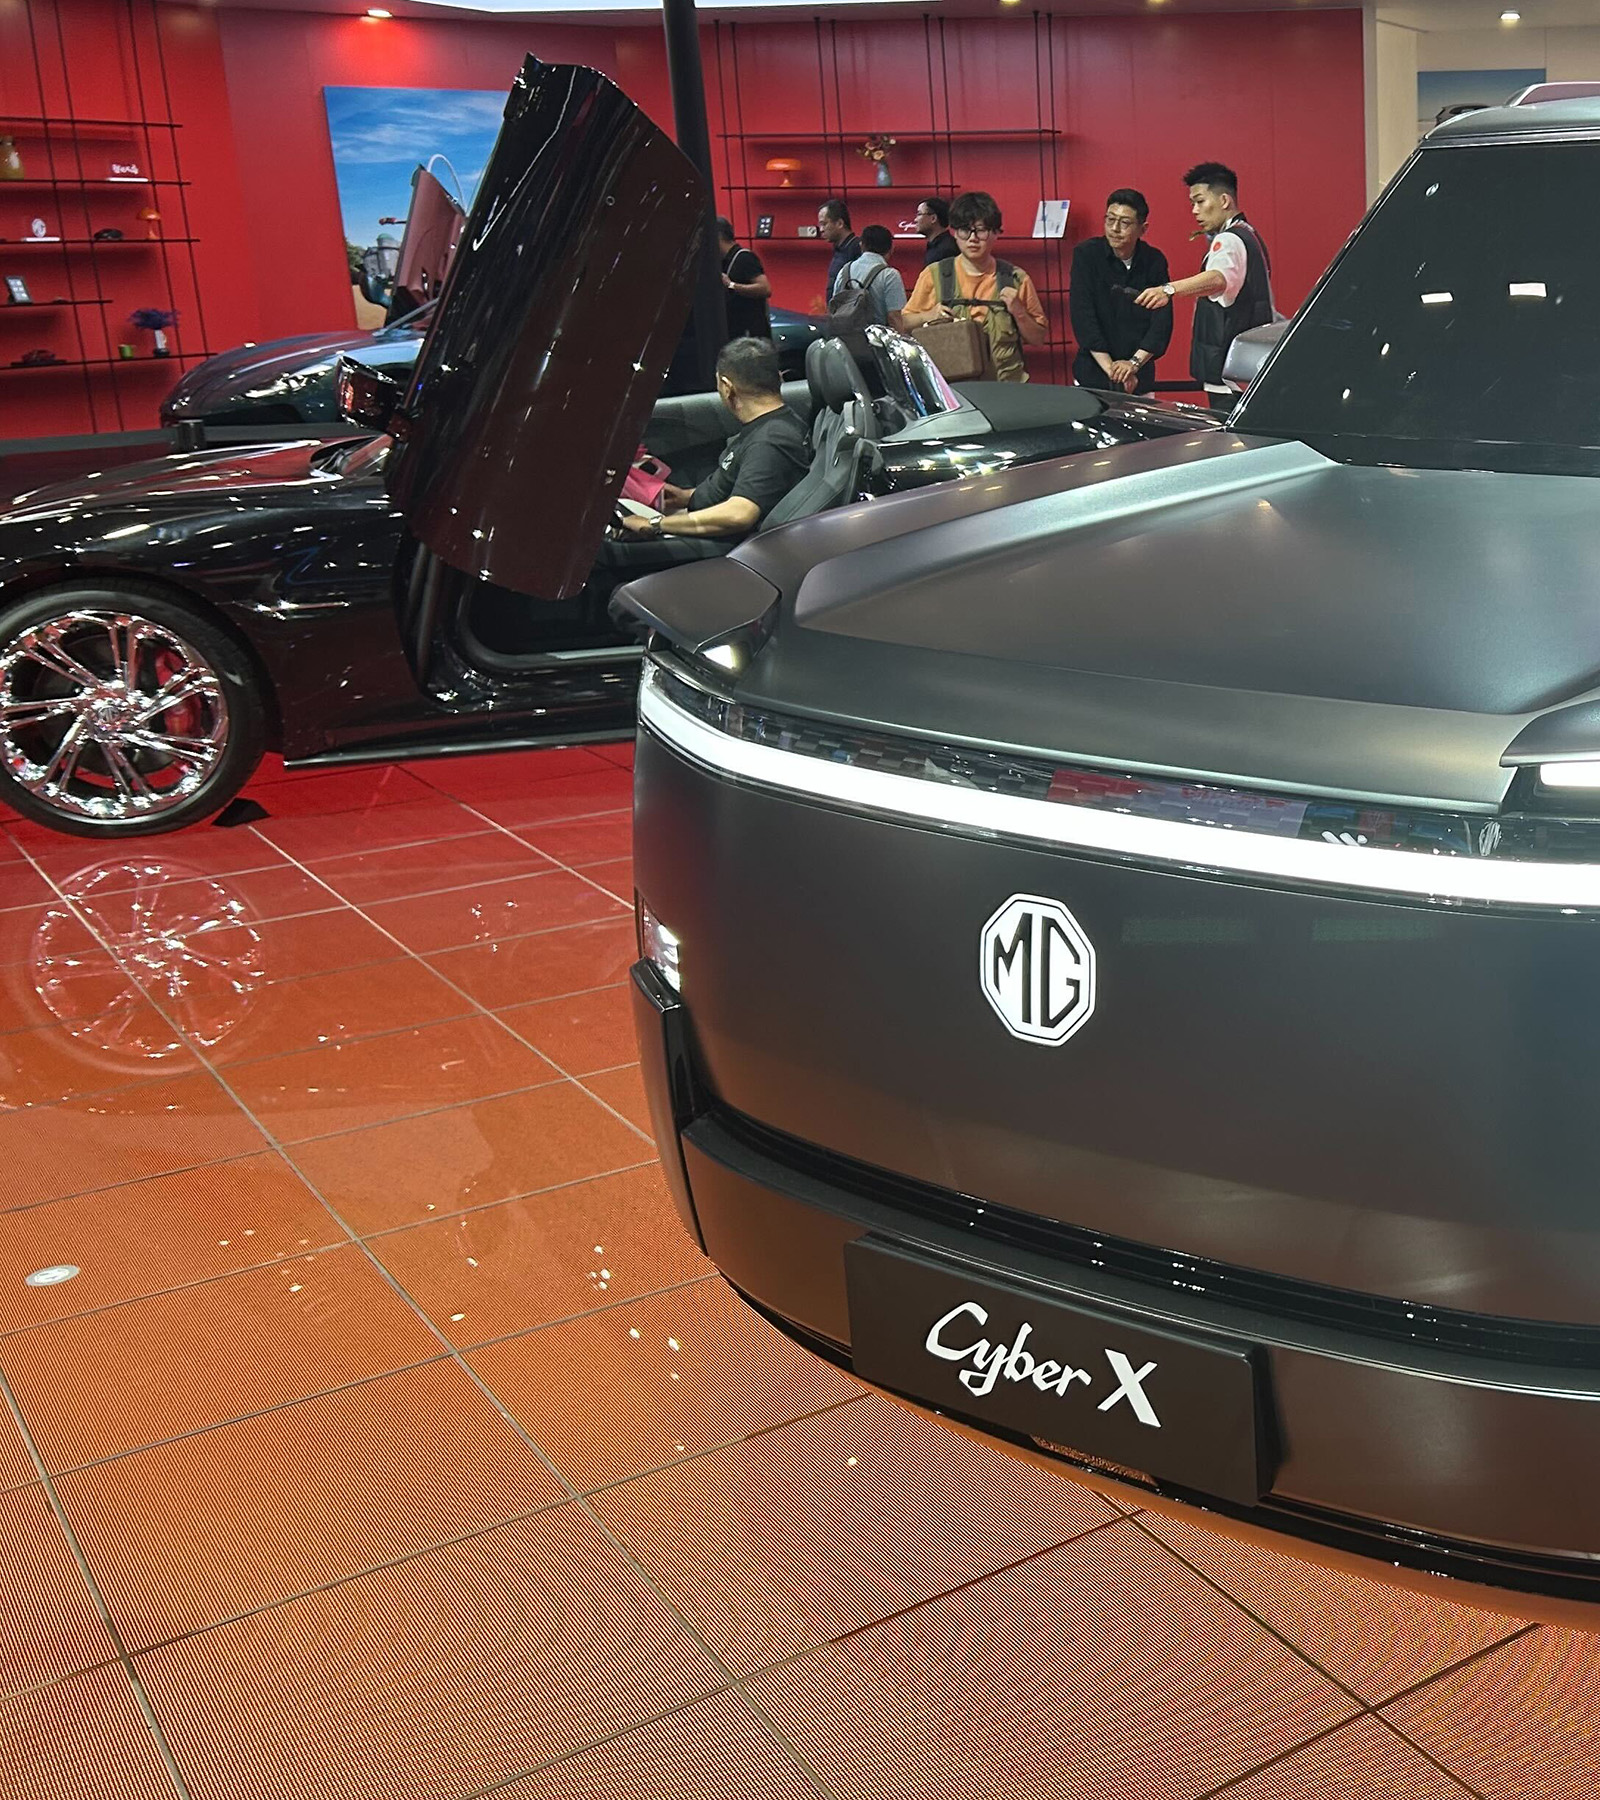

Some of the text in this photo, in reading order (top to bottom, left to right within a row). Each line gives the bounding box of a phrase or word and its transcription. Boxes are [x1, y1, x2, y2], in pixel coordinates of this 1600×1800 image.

[992, 911, 1082, 1030] MG
[925, 1301, 1162, 1428] Cyber X
